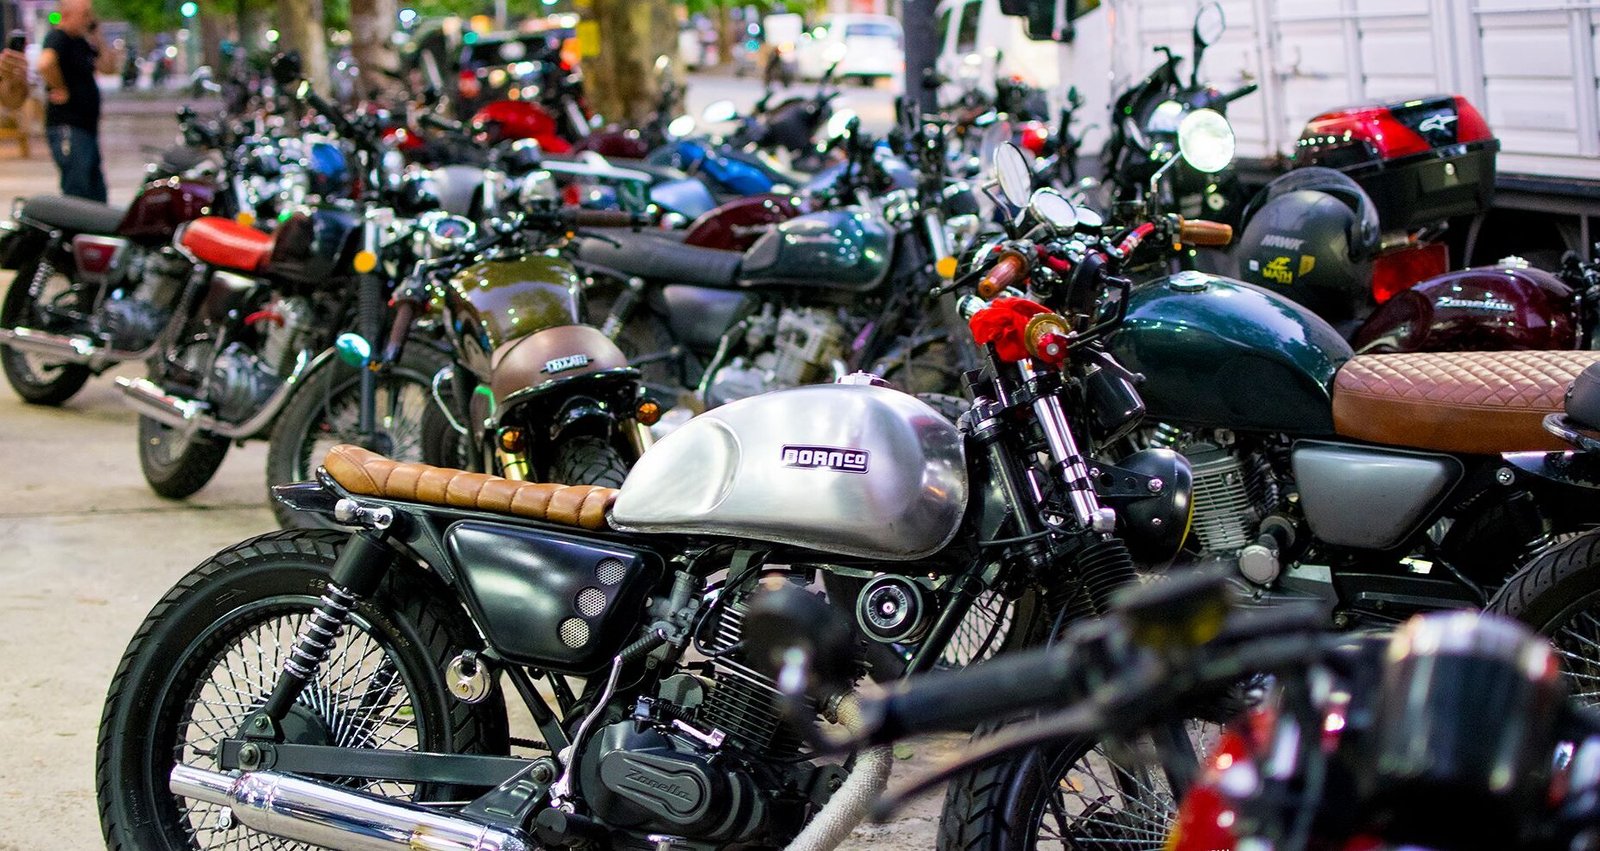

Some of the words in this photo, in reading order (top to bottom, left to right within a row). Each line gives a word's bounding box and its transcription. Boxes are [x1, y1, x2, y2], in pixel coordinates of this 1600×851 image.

[1260, 234, 1304, 250] HAWK
[1435, 296, 1515, 312] Zanella
[624, 768, 693, 802] Zanella
